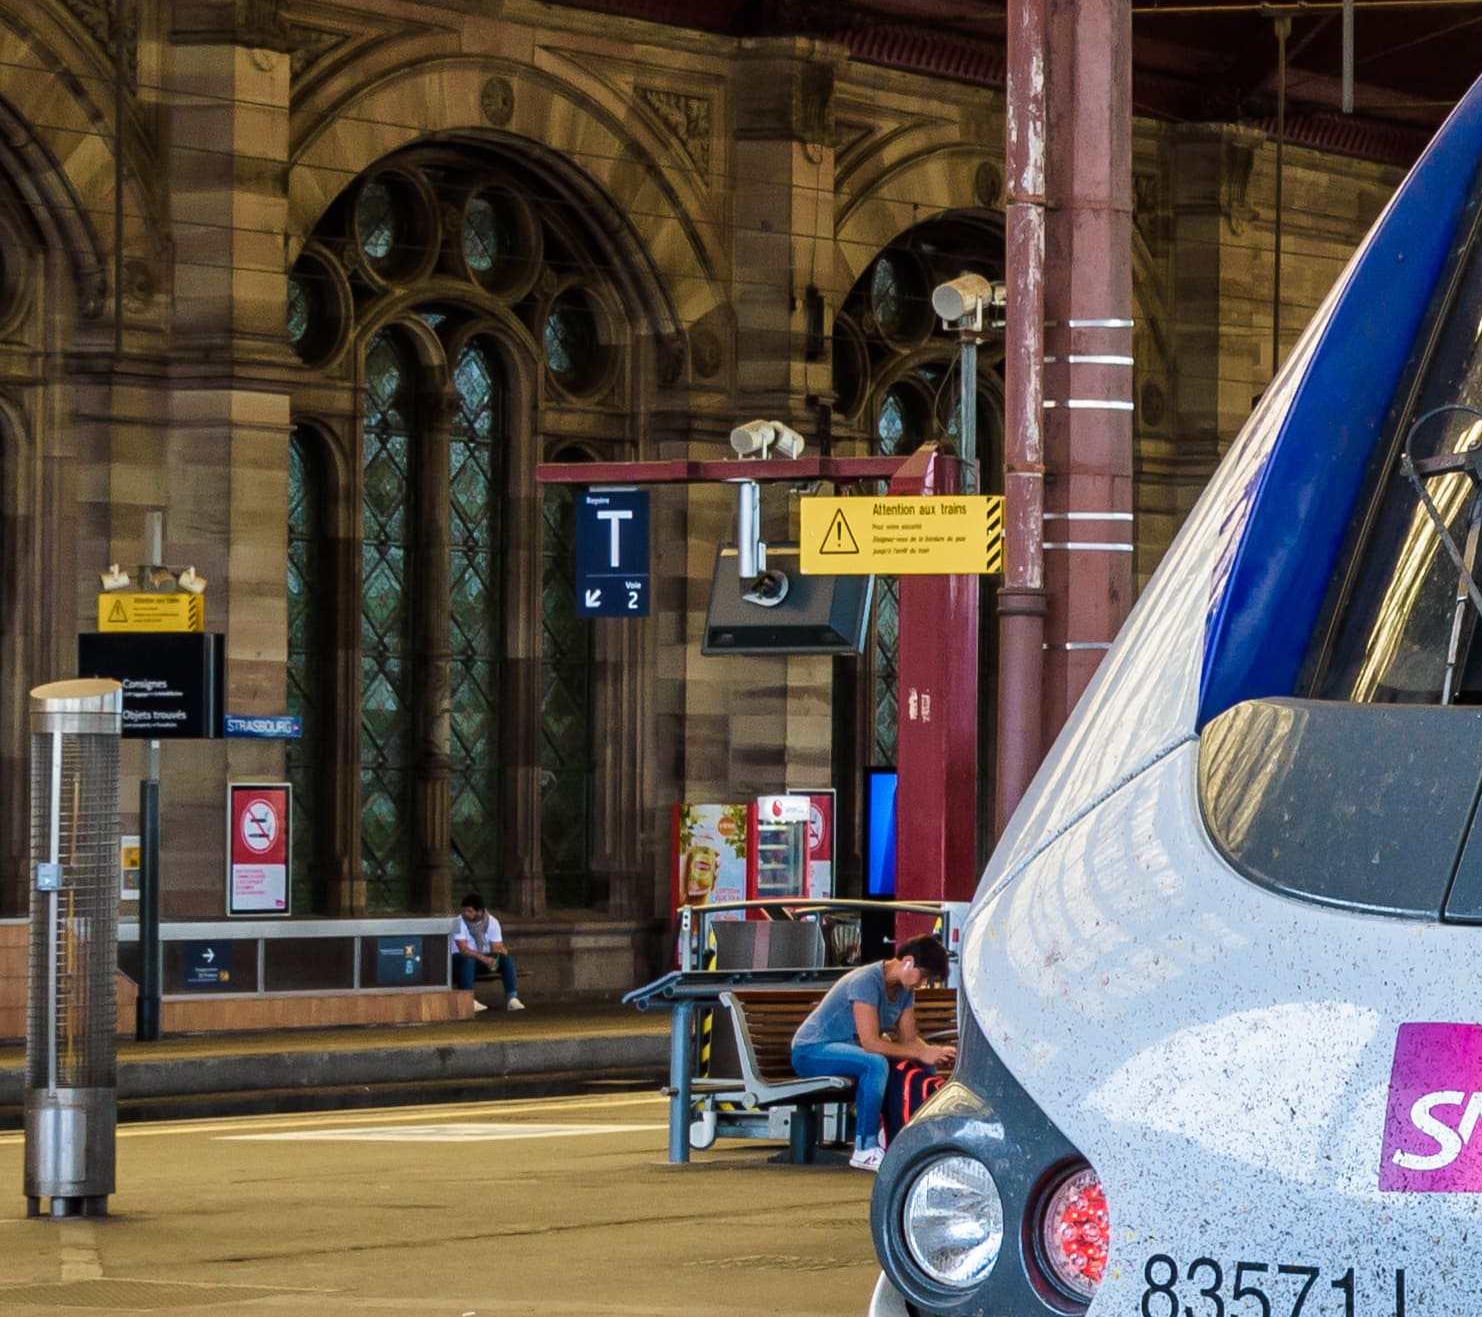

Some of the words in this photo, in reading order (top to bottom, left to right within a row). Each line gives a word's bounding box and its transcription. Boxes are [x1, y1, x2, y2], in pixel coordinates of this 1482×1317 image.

[872, 503, 915, 516] Attention
[919, 505, 936, 516] aux
[940, 503, 967, 516] trains
[596, 510, 633, 568] T
[625, 581, 642, 589] Voie
[628, 591, 638, 609] 2
[122, 679, 167, 691] Consignes
[122, 711, 151, 722] Objets
[153, 710, 187, 720] trouvés
[227, 719, 292, 733] STRASBOURG
